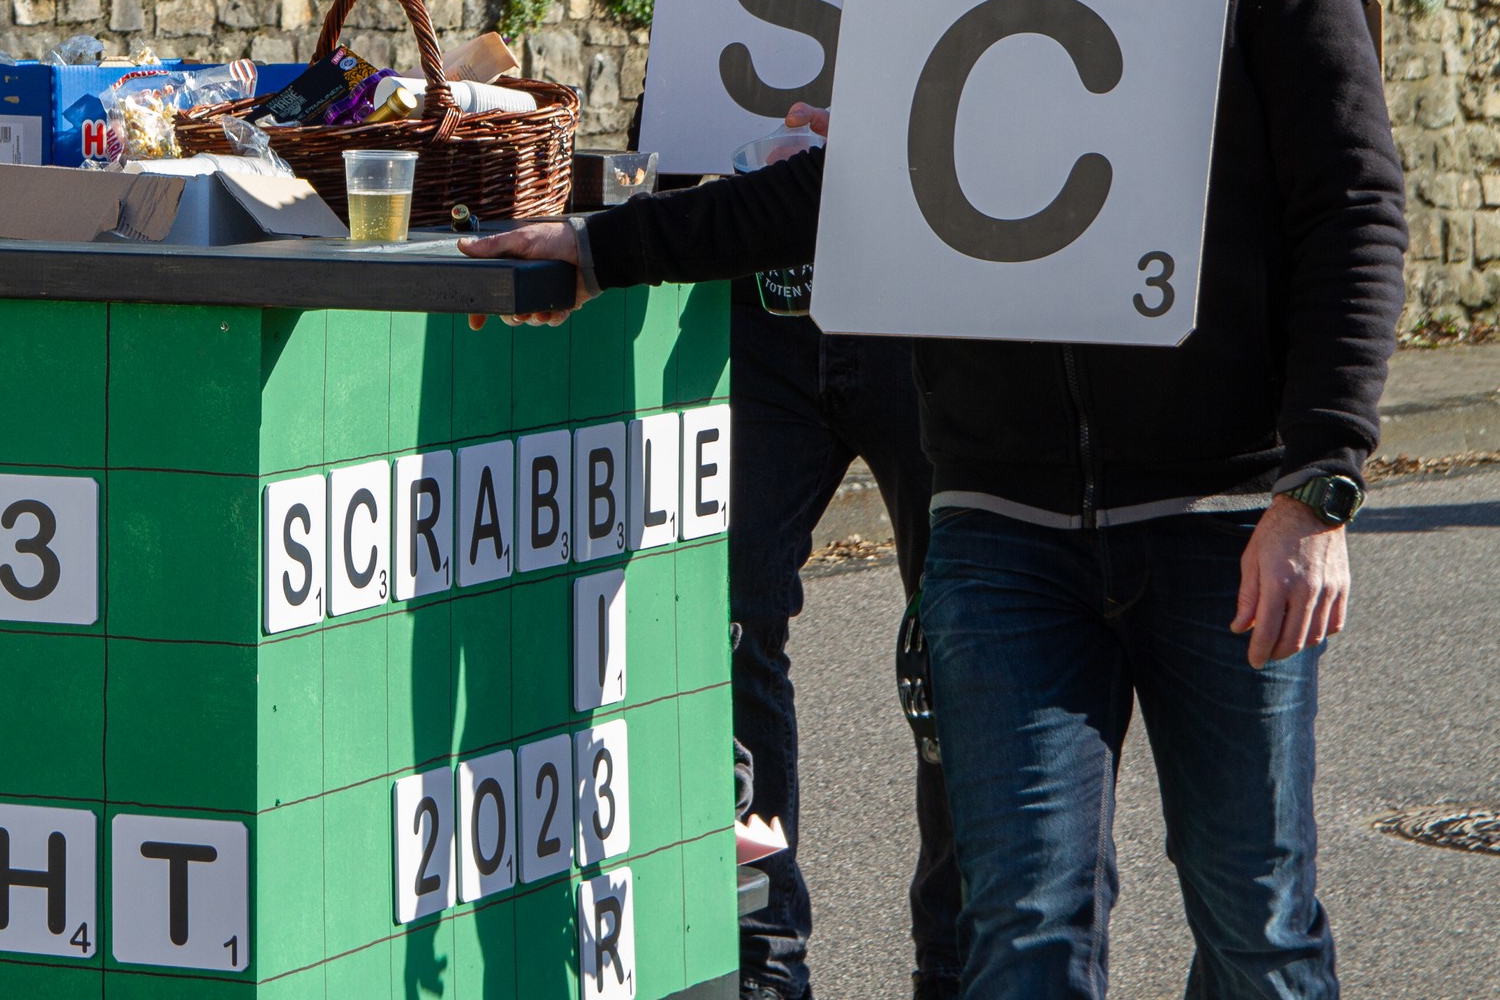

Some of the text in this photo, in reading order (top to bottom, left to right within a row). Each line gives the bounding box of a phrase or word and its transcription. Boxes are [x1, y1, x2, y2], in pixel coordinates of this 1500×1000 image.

[765, 277, 802, 298] TOTEN
[1133, 251, 1175, 317] 3
[282, 428, 720, 607] SCRABBLE
[669, 511, 676, 535] 1
[722, 503, 728, 527] 1
[560, 533, 569, 560] 3
[616, 522, 625, 549] 3
[443, 559, 451, 584] 1
[502, 547, 510, 572] 1
[379, 570, 387, 599] 3
[315, 590, 323, 616] 1
[70, 922, 91, 953] 4
[224, 935, 237, 966] 1
